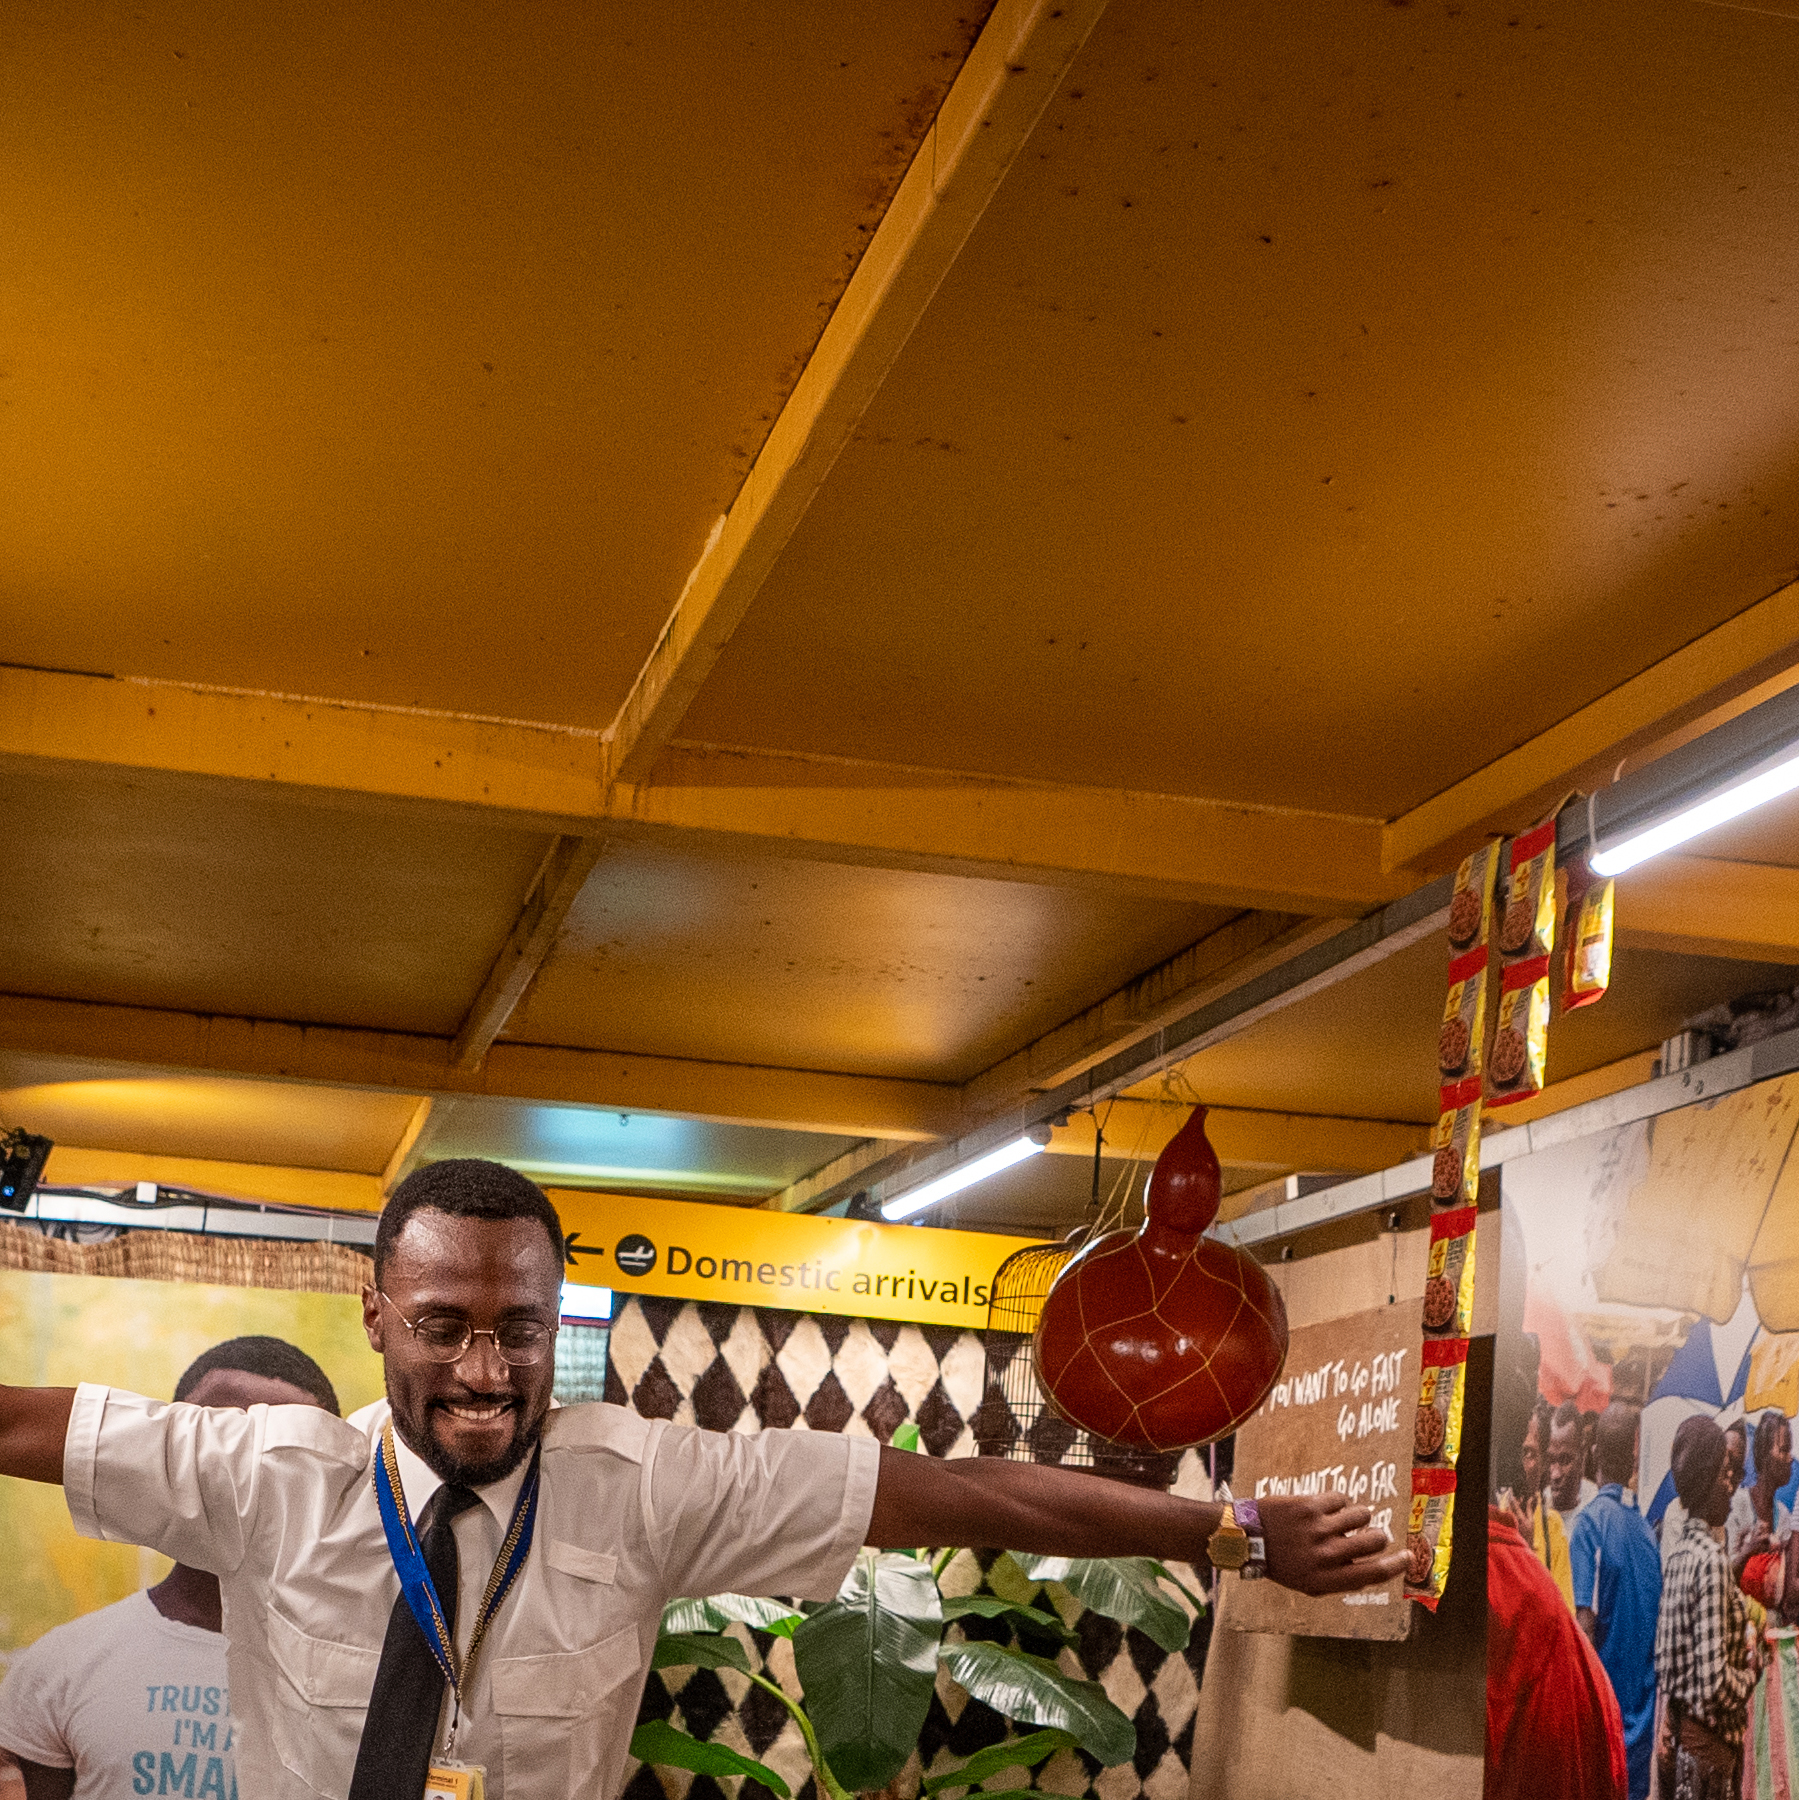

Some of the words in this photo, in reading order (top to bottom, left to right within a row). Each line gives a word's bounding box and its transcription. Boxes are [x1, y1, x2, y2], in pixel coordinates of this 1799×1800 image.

[667, 1246, 841, 1293] Domestic
[852, 1271, 989, 1307] arrivals
[1294, 1361, 1333, 1406] WANT
[1332, 1359, 1348, 1397] TO
[1351, 1361, 1369, 1396] GO
[1371, 1348, 1408, 1397] FAST
[1337, 1404, 1356, 1442] GO
[1357, 1396, 1401, 1438] ALONE
[1349, 1466, 1368, 1504] GO
[1370, 1460, 1398, 1502] FAR
[173, 1719, 217, 1751] I'M
